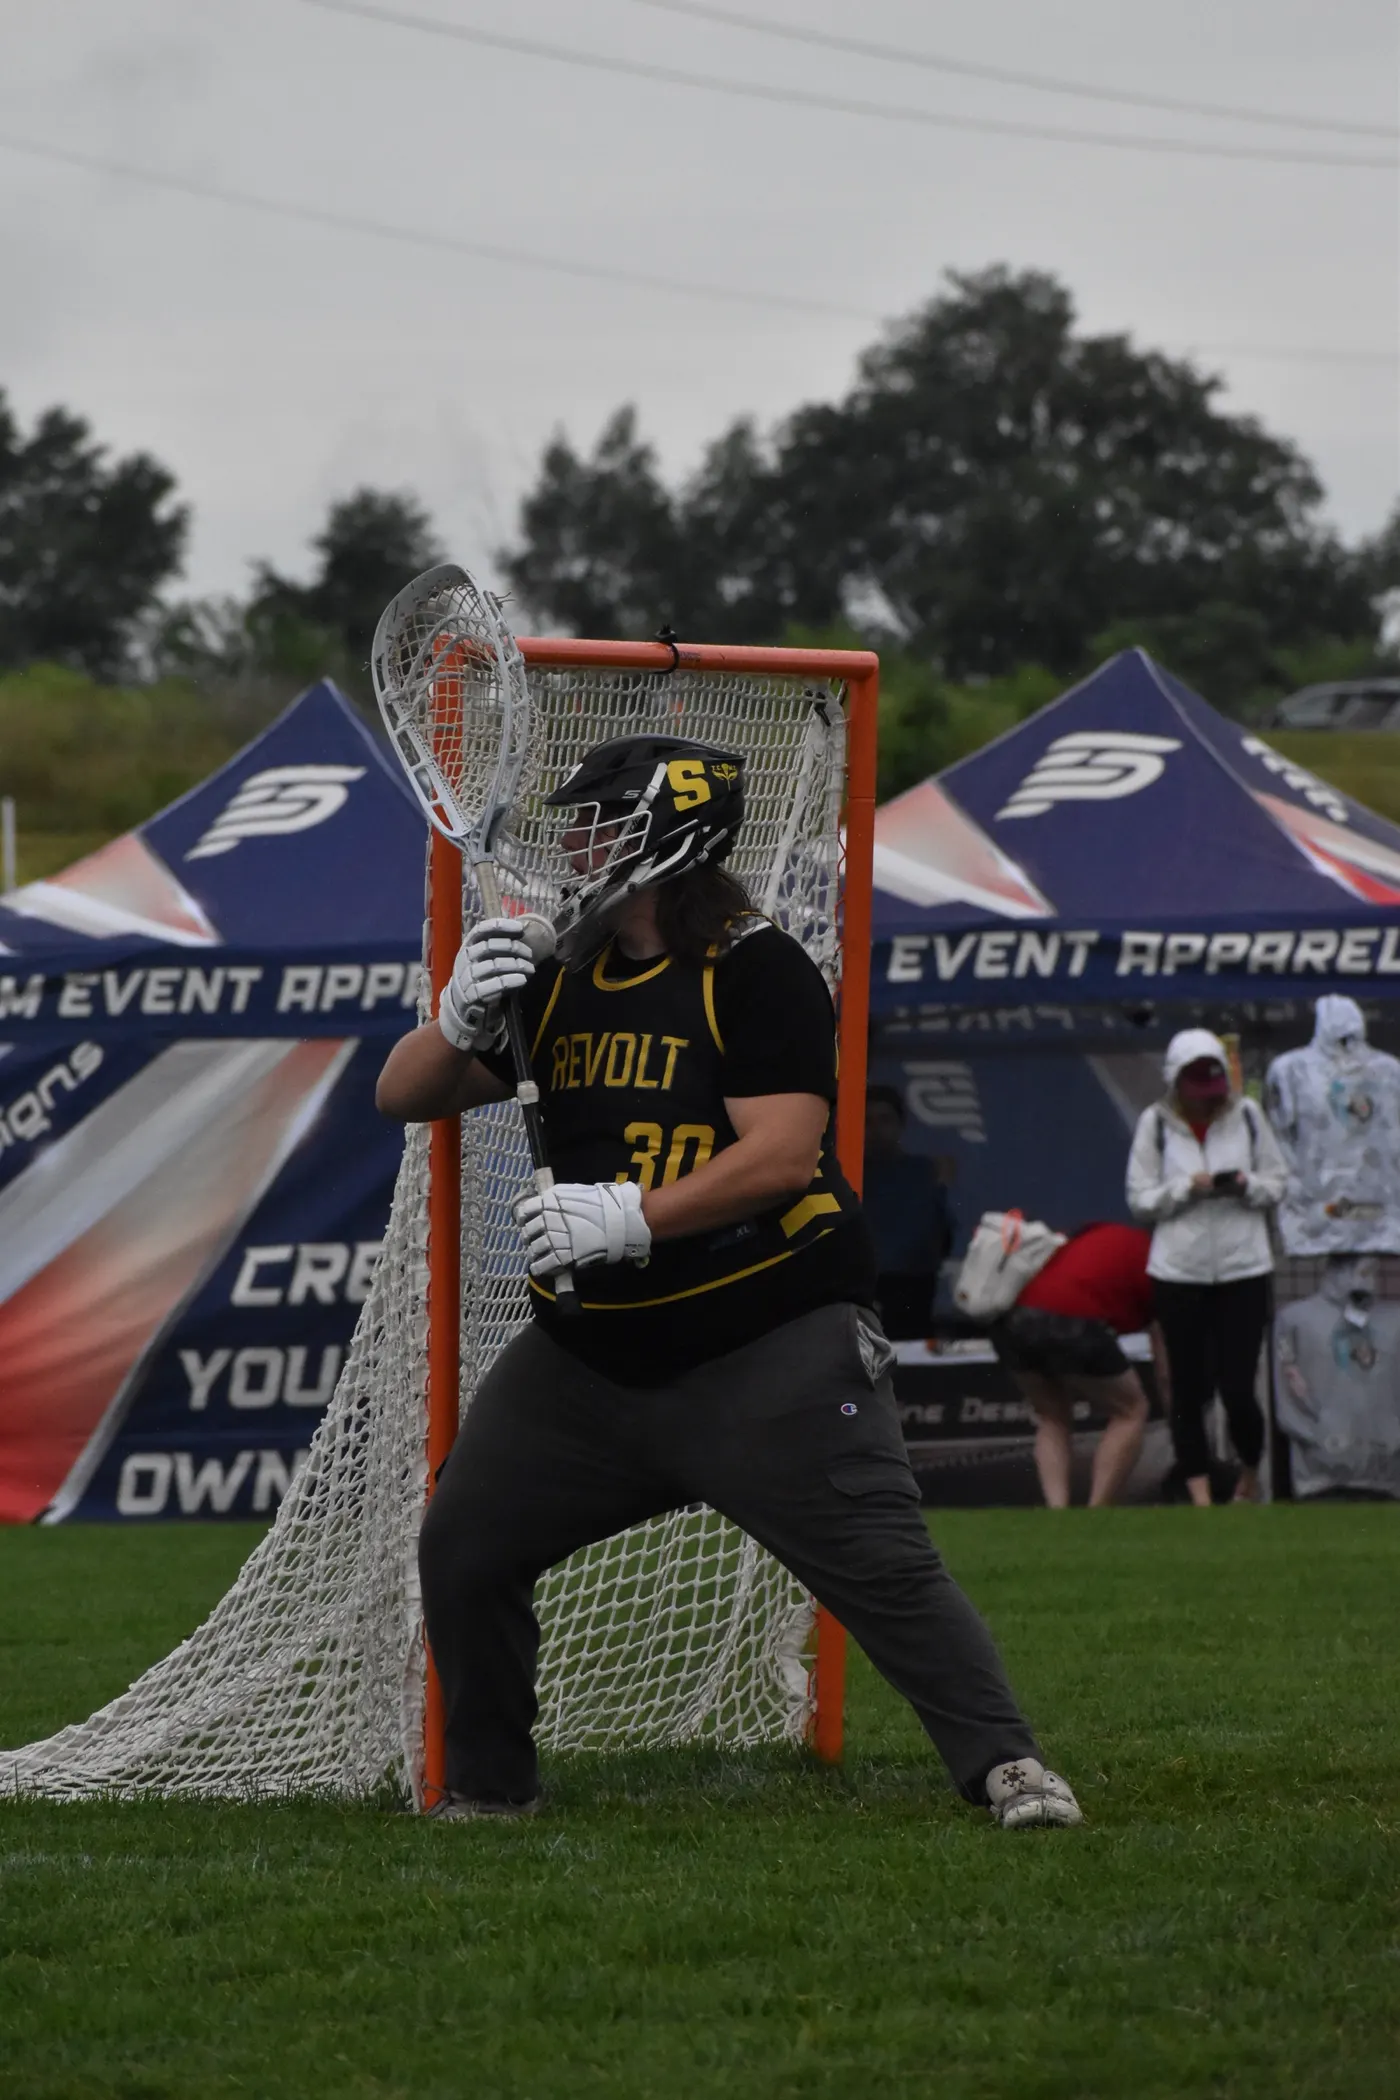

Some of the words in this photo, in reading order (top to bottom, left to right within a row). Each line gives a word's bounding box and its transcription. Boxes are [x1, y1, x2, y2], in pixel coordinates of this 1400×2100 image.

[666, 759, 712, 812] S
[886, 929, 1099, 983] EVENT
[1114, 926, 1400, 978] APPAREL
[57, 965, 264, 1018] EVENT
[551, 1031, 691, 1093] REVOLT
[615, 1121, 716, 1192] 30
[230, 1241, 384, 1307] CRE
[116, 1448, 310, 1517] OWN
